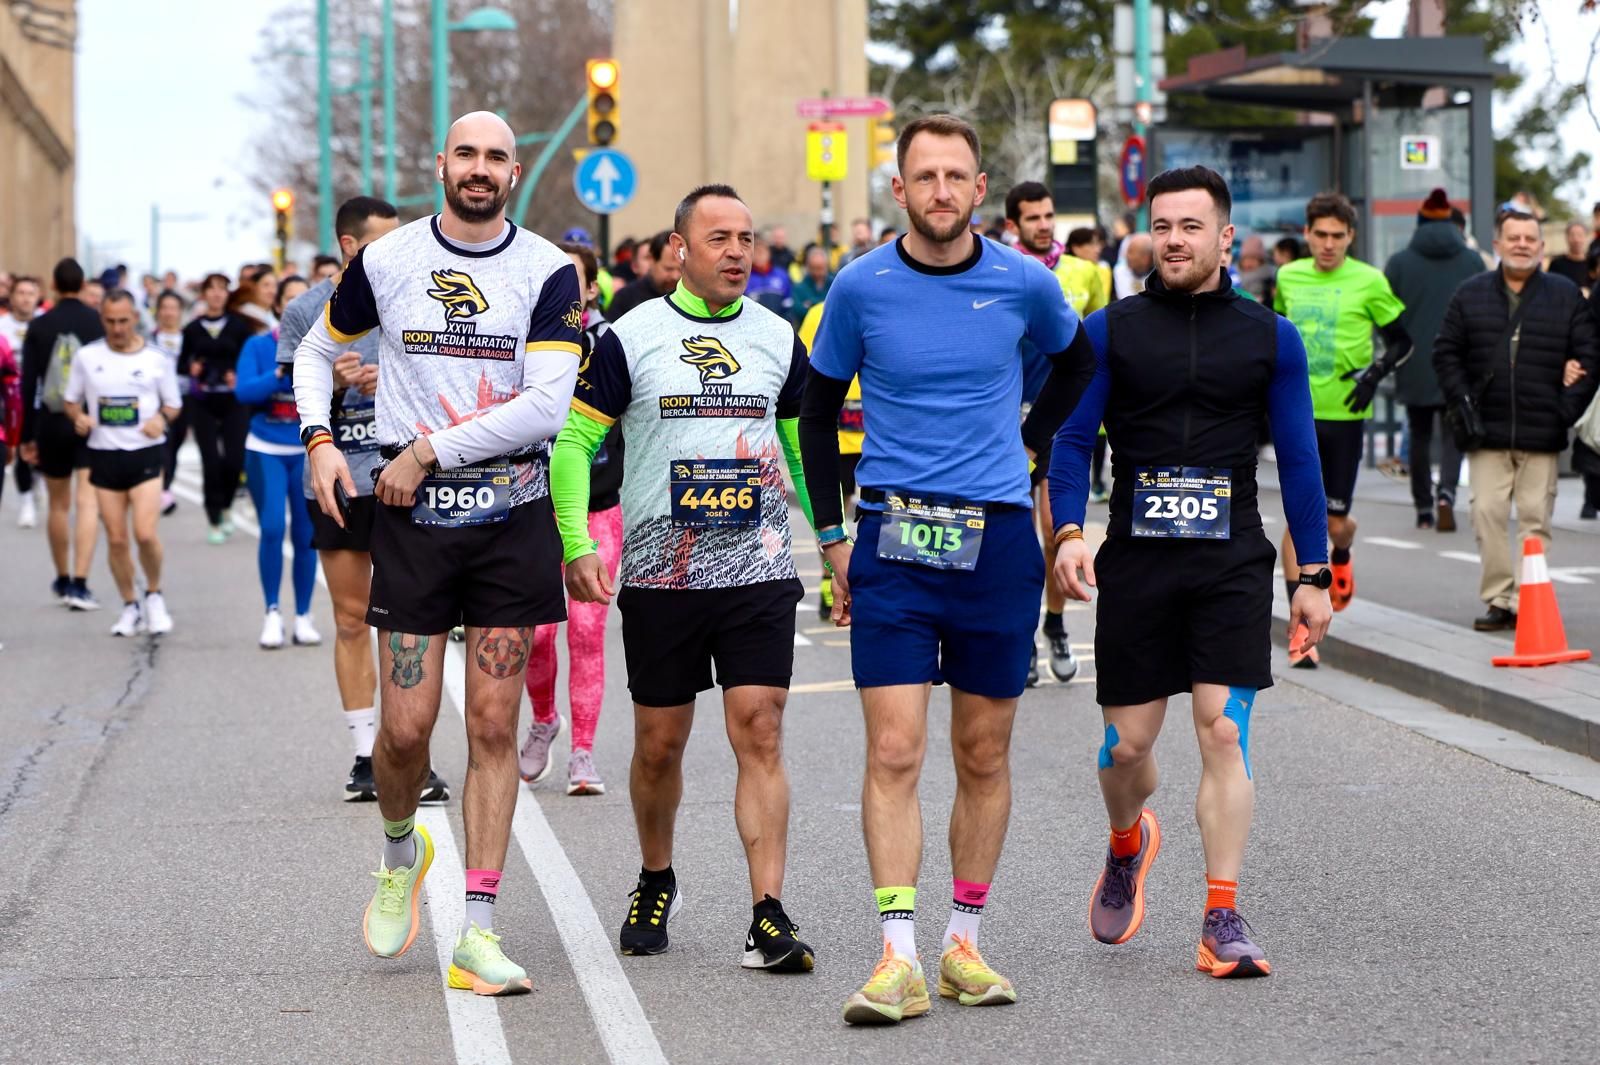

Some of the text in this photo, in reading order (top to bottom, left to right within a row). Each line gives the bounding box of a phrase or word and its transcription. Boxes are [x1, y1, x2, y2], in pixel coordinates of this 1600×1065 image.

[447, 322, 475, 334] XXVII
[404, 332, 515, 350] RODI MEDIA MARATÓN
[438, 346, 466, 356] CIUDAD
[467, 348, 478, 357] DE
[477, 349, 513, 359] ZARAGOZA
[703, 385, 730, 395] XXVII
[661, 395, 768, 408] RODI MEDIA MARATÓN
[662, 408, 696, 417] IBERCAJA
[697, 408, 722, 416] CIUDAD
[723, 408, 733, 416] DE
[425, 486, 495, 509] 1960
[679, 487, 753, 510] 4466
[1144, 496, 1218, 520] 2305
[900, 521, 962, 552] 1013
